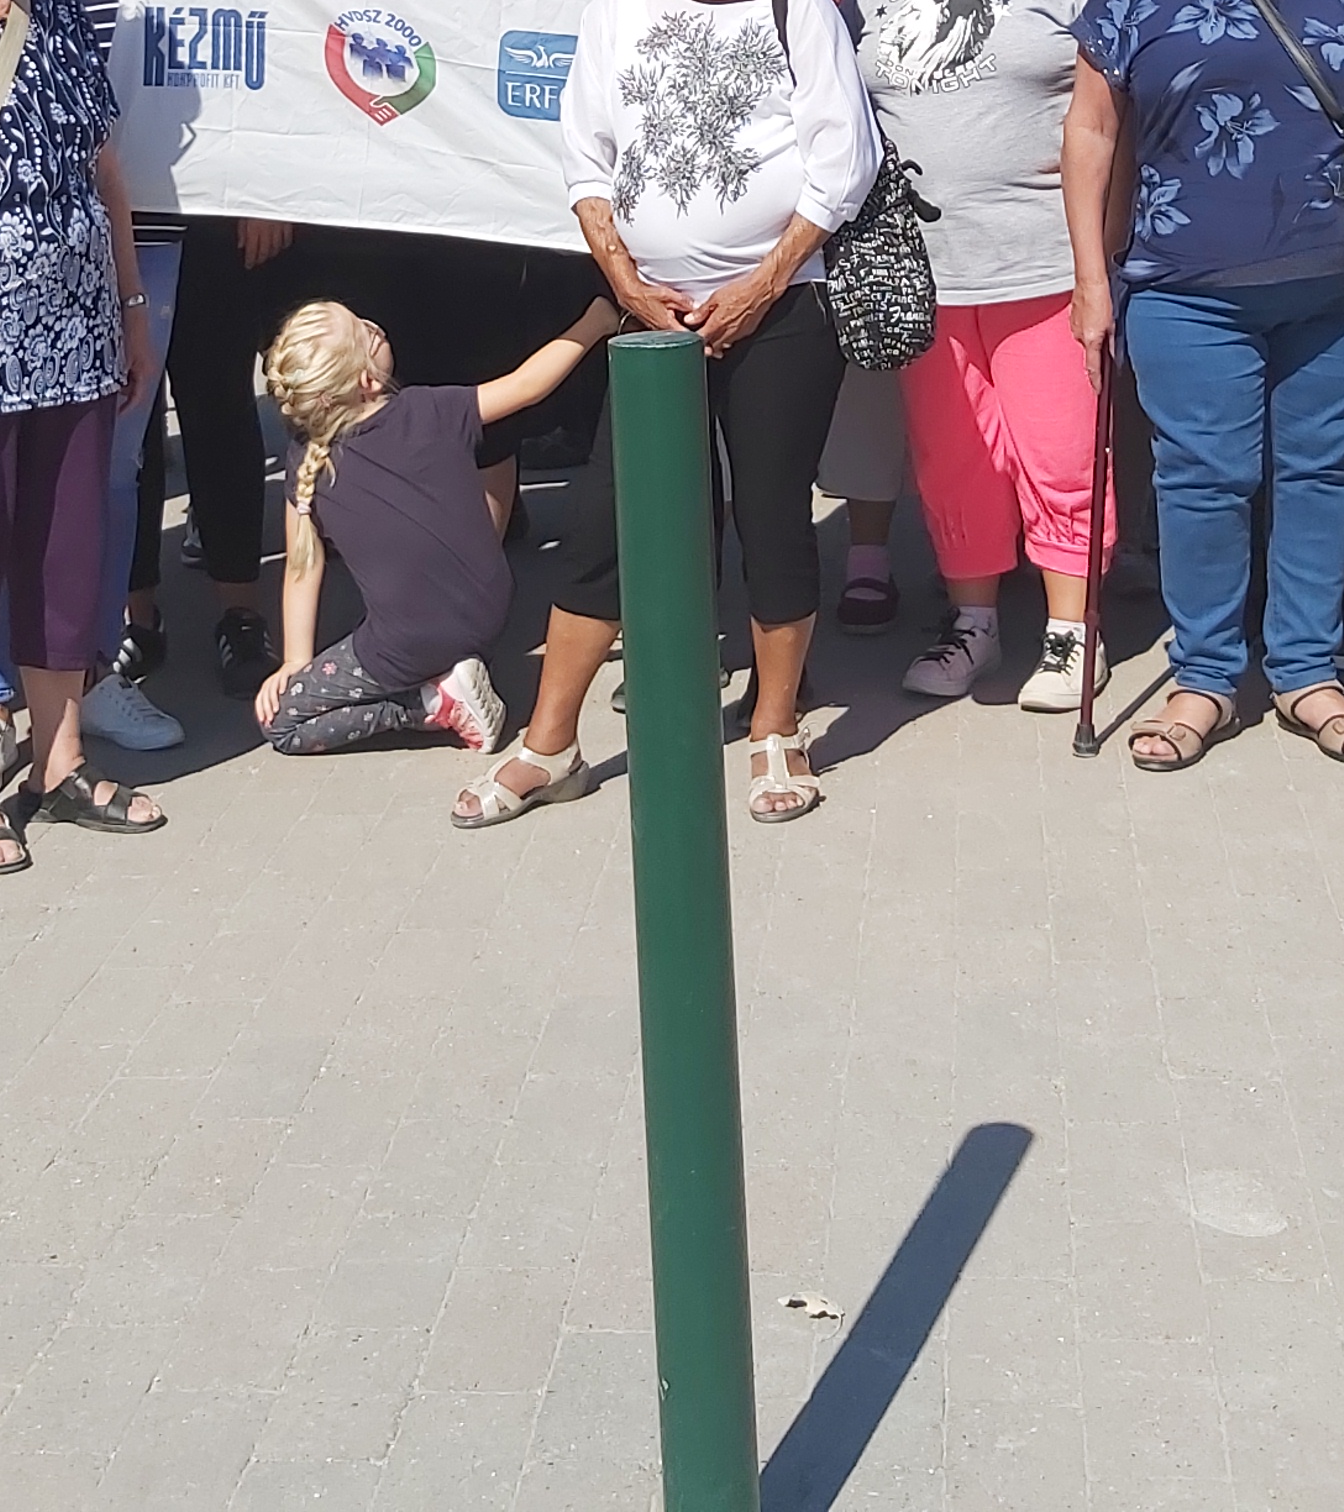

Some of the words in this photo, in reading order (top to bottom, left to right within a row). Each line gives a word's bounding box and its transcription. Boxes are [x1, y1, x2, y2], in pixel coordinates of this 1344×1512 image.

[334, 9, 383, 32] HVDSZ
[384, 13, 423, 47] 2000
[143, 7, 269, 90] KÉZMŰ
[875, 53, 997, 94] TONIGHT
[505, 81, 560, 110] ERF
